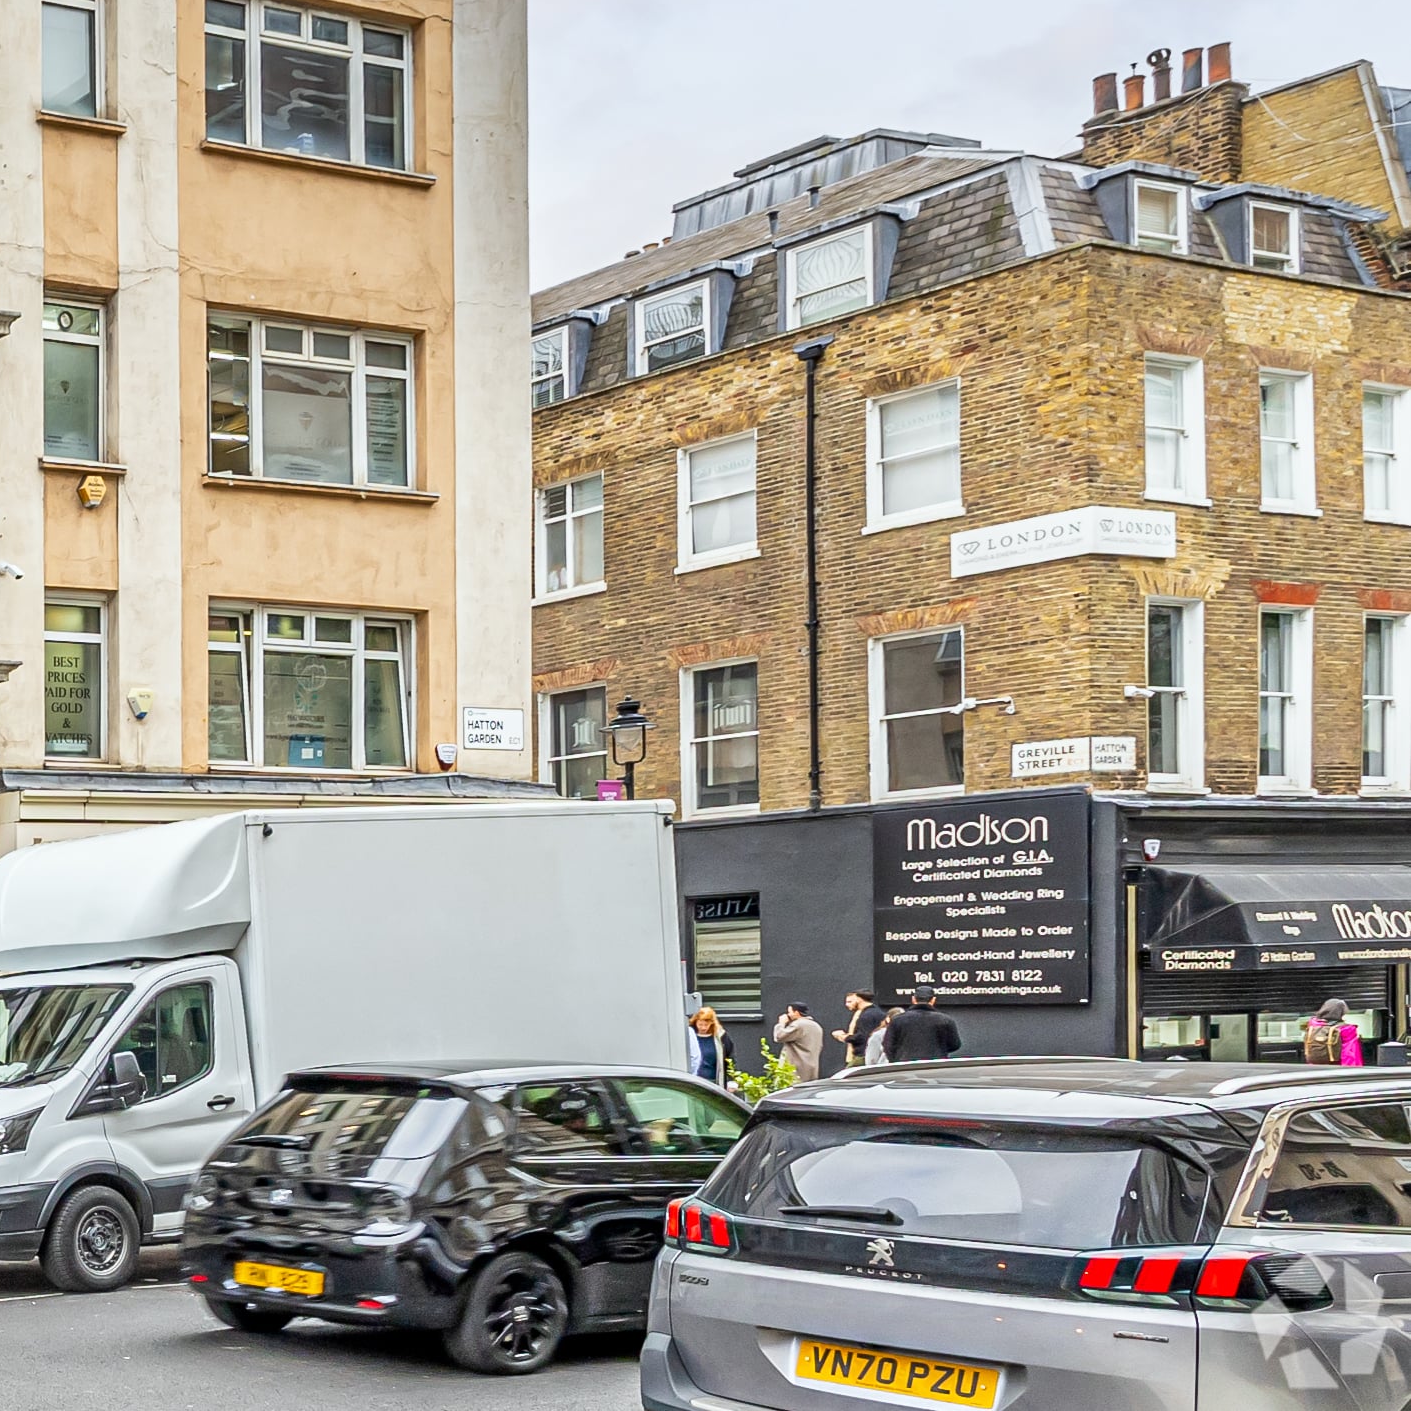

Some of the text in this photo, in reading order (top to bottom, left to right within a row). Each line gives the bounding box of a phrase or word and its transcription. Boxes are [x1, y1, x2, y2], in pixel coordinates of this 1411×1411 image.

[1118, 519, 1172, 536] LONDON
[987, 521, 1082, 551] LONDON
[53, 656, 80, 668] BEST
[47, 671, 86, 684] PRICES
[69, 688, 91, 699] FOR
[51, 702, 83, 714] GOLD
[62, 717, 71, 729] &
[468, 720, 504, 731] HATTON
[468, 733, 502, 744] GARDEN
[1018, 745, 1075, 759] GREVILLE
[1095, 743, 1127, 753] HATTON
[1018, 758, 1063, 770] STREET
[1094, 755, 1123, 764] GARDEN
[906, 813, 1049, 851] Madison
[902, 860, 933, 872] Large
[936, 856, 989, 868] Selection
[992, 855, 1005, 865] of
[912, 866, 1043, 883] Certificated Diamonds
[894, 888, 1065, 907] Engagement & Wedding Ring
[945, 905, 1006, 918] Specialists
[1331, 903, 1411, 938] Madiso
[885, 925, 1074, 942] Bespoke Designs Made to Order
[883, 948, 1076, 964] Buyers of Second-Hand Jewellery
[1161, 949, 1236, 960] Certificated
[1165, 959, 1232, 970] Diamonds
[941, 971, 969, 983] 020
[975, 970, 1006, 982] 7831
[1011, 969, 1043, 982] 8122
[845, 1265, 923, 1280] PEUGEOT
[813, 1345, 981, 1399] VN70 PZU
